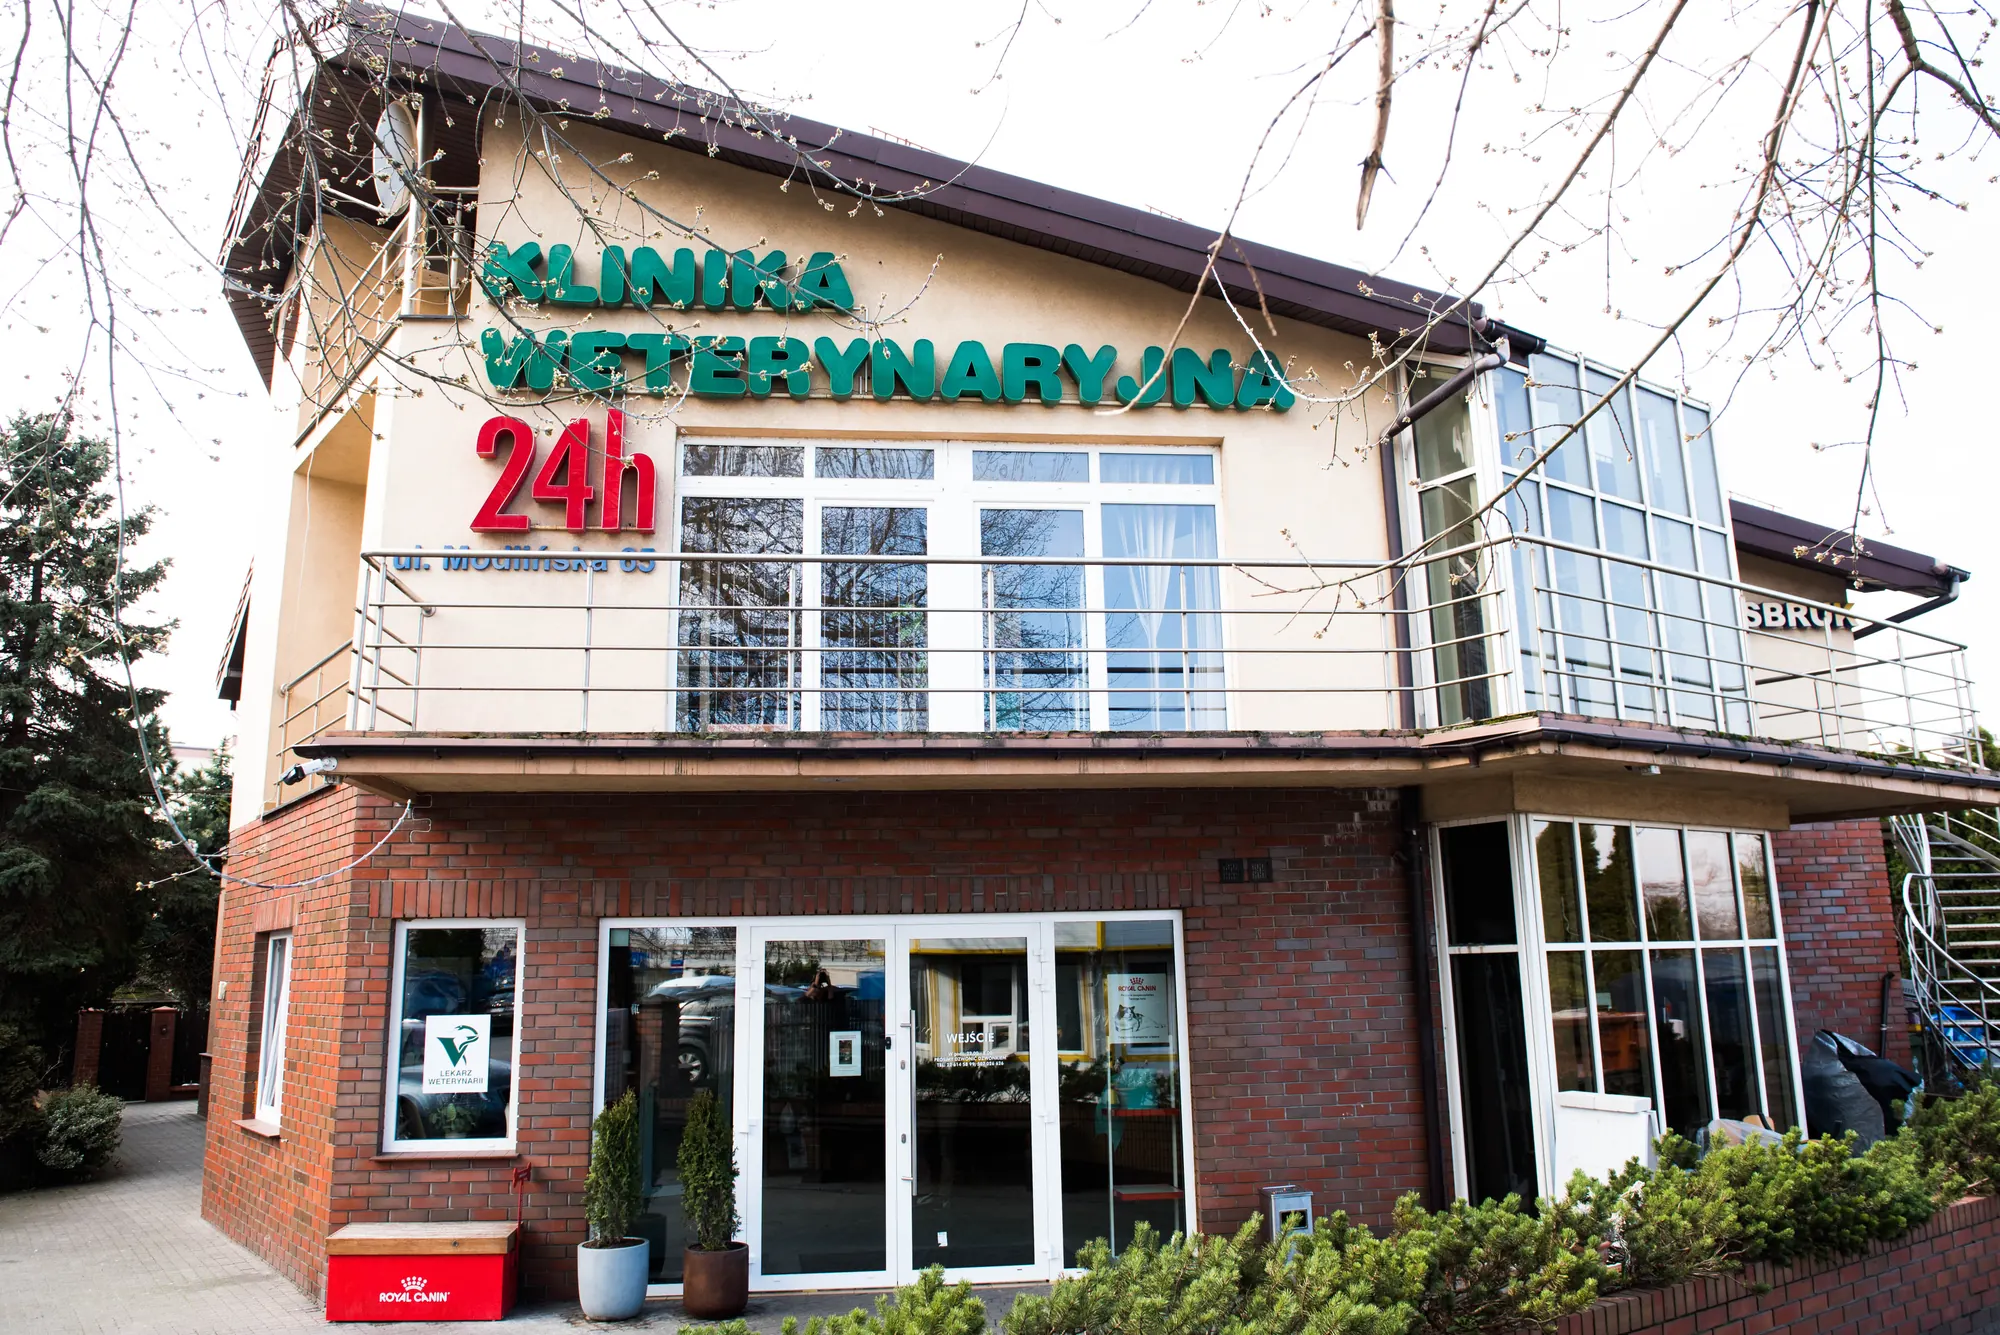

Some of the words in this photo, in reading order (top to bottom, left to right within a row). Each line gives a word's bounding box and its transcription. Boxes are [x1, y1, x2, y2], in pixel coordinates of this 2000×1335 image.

[482, 241, 855, 315] KLINIKA
[481, 327, 1296, 413] WETERYNARYJNA
[470, 408, 658, 534] 24h
[393, 545, 430, 570] ul.
[442, 545, 608, 572] Modlińska
[946, 1031, 994, 1043] WEJŚCIE
[379, 1292, 412, 1302] ROYAL
[413, 1292, 447, 1302] CANIN
